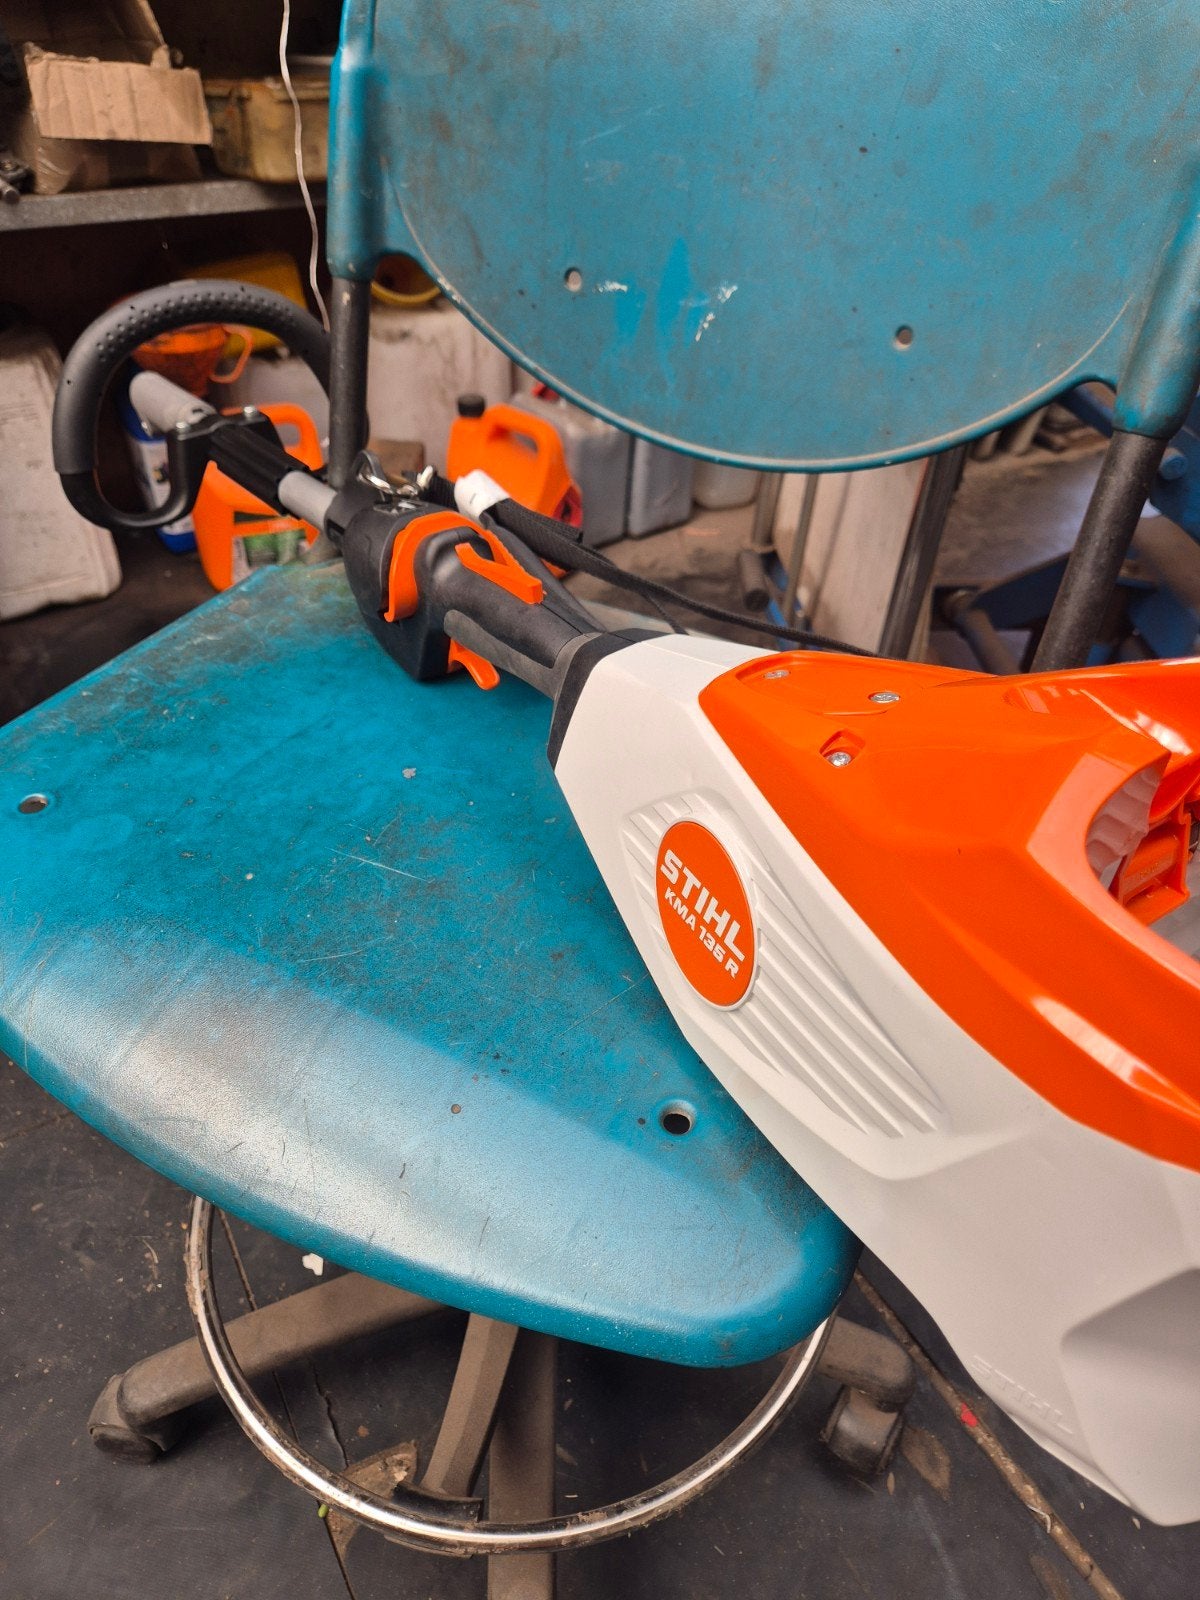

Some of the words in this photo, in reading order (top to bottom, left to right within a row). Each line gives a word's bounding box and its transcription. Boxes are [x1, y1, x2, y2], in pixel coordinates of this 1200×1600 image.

[660, 849, 745, 962] STIHL
[664, 886, 696, 931] KMA
[699, 926, 726, 962] 135
[725, 958, 740, 979] R
